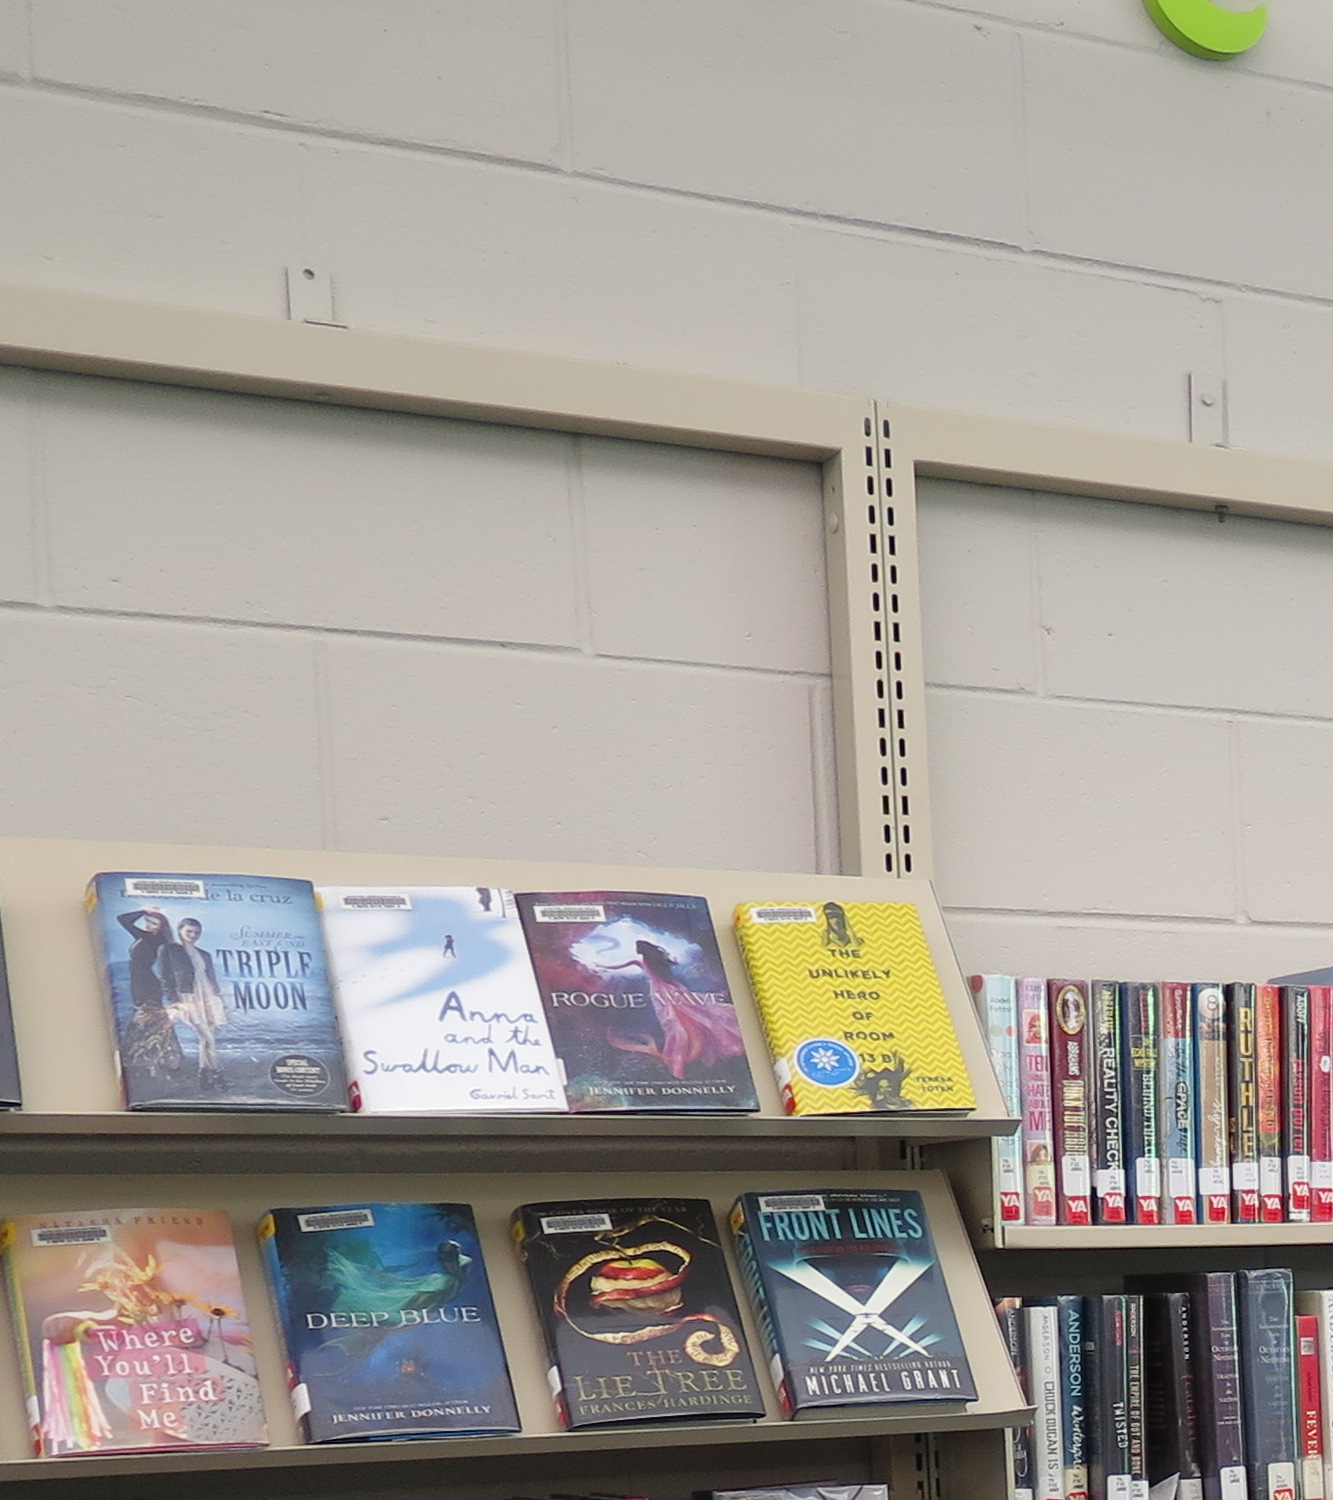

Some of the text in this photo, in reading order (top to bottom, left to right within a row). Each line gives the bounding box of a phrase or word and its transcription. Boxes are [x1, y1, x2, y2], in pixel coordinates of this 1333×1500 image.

[216, 949, 313, 979] TRIPLE
[828, 948, 861, 959] THE
[809, 969, 891, 980] UNLIKELY
[232, 981, 308, 1013] MOON
[551, 991, 729, 1009] ROGUE WAVE
[833, 989, 880, 1001] HERO
[438, 991, 539, 1023] Anna
[852, 1011, 873, 1021] OF
[445, 1028, 541, 1047] and the
[844, 1031, 894, 1042] ROOM
[363, 1048, 549, 1075] Swallow Man
[860, 1053, 892, 1063] 13 B
[588, 1084, 736, 1096] JENNIFER DONNELLY
[915, 1076, 953, 1084] TERESA
[759, 1208, 924, 1241] FRONT LINES
[306, 1307, 480, 1330] DEEP BLUE
[96, 1326, 195, 1351] Where
[627, 1350, 682, 1366] THE
[1068, 1309, 1082, 1397] ANDERSON
[95, 1354, 193, 1377] You'll
[141, 1381, 217, 1404] Find
[573, 1368, 747, 1401] LIE TREE
[805, 1369, 962, 1396] MICHAEL GRANT
[331, 1404, 491, 1425] JENNIFER DONNELLY
[579, 1393, 752, 1416] FRANCES HARDINGE
[139, 1409, 179, 1429] Me
[1112, 1402, 1128, 1449] TWISTED
